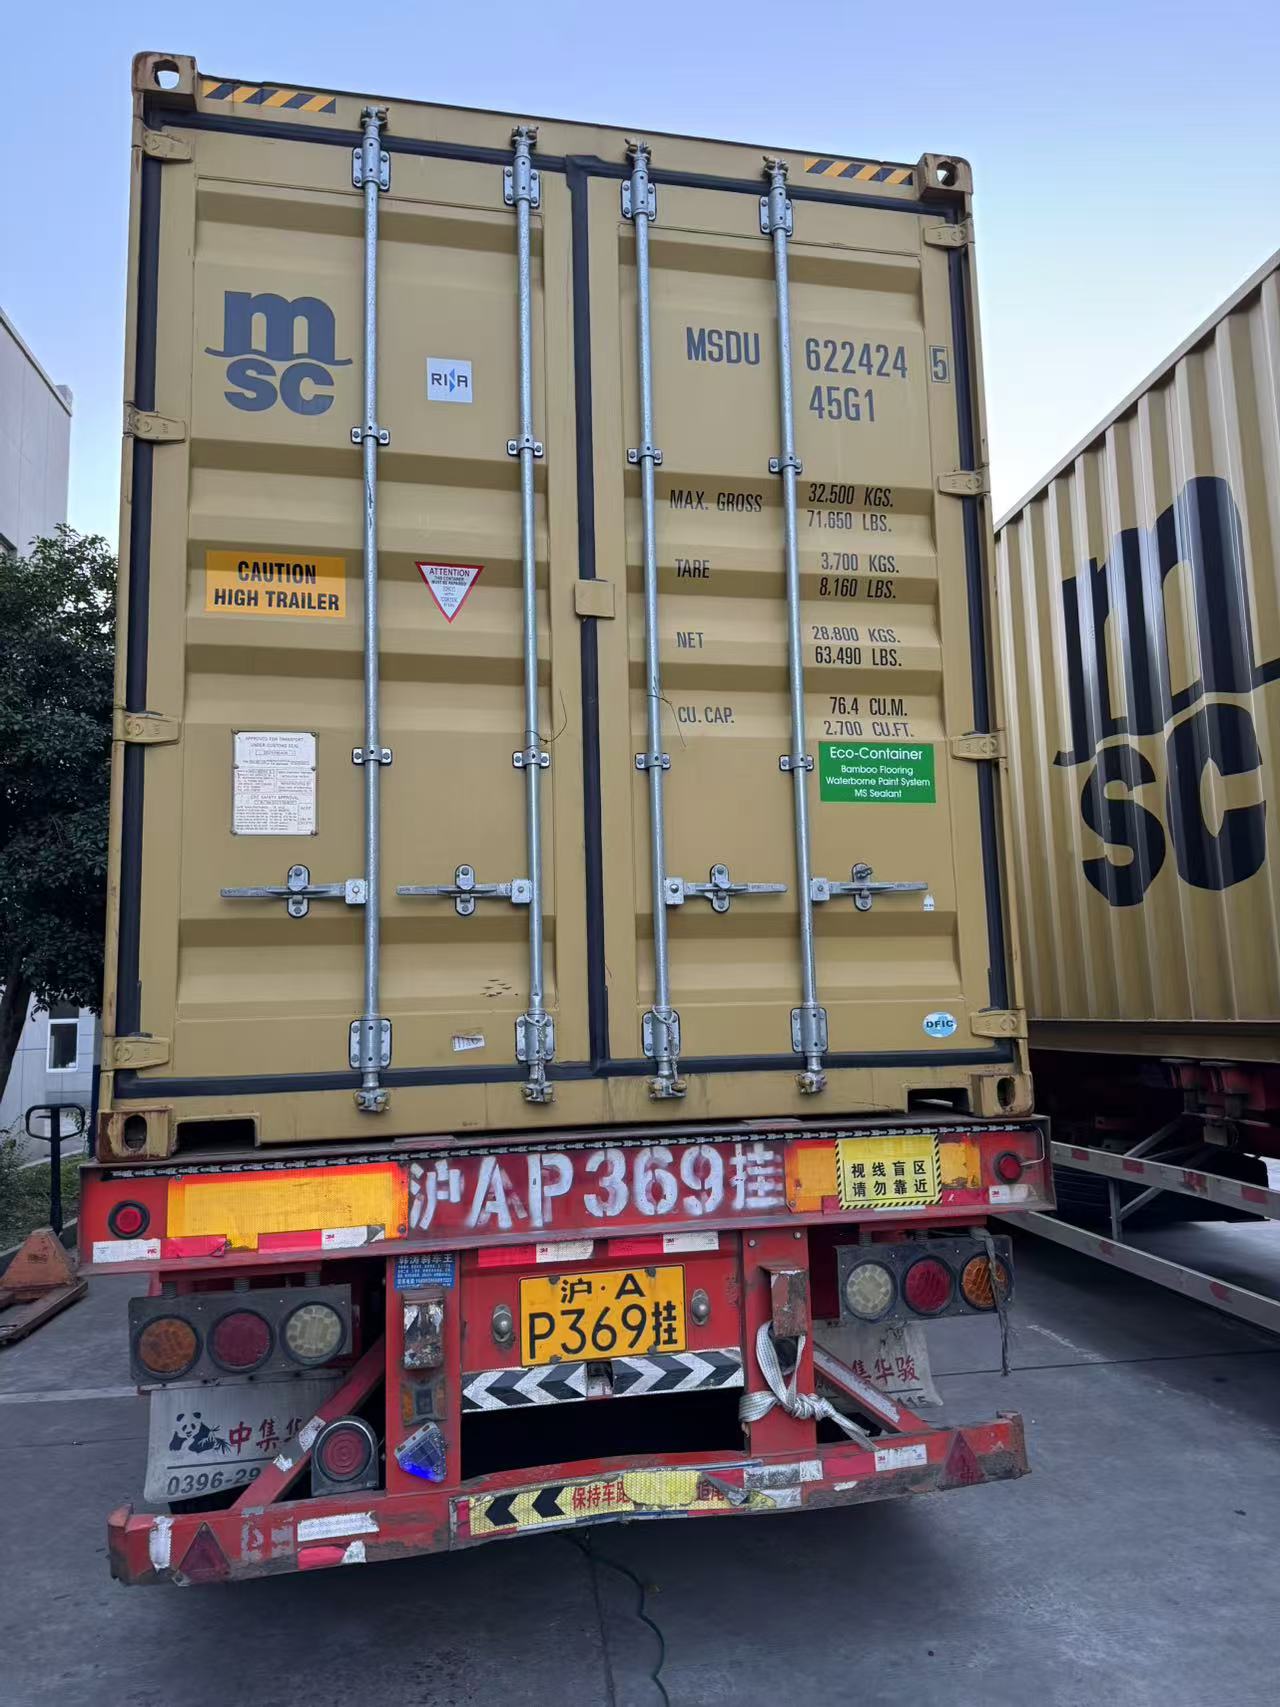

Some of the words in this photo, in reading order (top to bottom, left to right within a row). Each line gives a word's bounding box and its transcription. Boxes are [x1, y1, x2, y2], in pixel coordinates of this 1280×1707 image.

[686, 326, 760, 365] MSDU
[805, 338, 907, 378] 622424
[932, 347, 948, 381] 5
[809, 385, 875, 422] 45G1
[670, 490, 708, 511] MAX.
[717, 492, 762, 512] GROSS
[864, 487, 894, 508] KGS.
[863, 513, 892, 533] LBS.
[238, 560, 316, 584] CAUTION
[429, 567, 470, 577] ATTENTION
[675, 558, 710, 578] TARE
[869, 555, 900, 574] KGS.
[867, 580, 897, 599] LBS.
[214, 588, 259, 607] HIGH
[265, 590, 340, 611] TRAILER
[677, 631, 704, 648] NET
[868, 628, 901, 643] KGS.
[872, 649, 902, 666] LBS.
[705, 707, 735, 723] CAP.
[829, 696, 859, 715] 76.4
[829, 746, 923, 760] Eco-Container
[841, 765, 878, 774] Bamboo
[880, 766, 914, 777] Flooring
[825, 776, 876, 786] Waterborne
[878, 777, 899, 786] Paint
[900, 778, 931, 787] System
[854, 789, 868, 797] MS
[869, 789, 902, 798] Sealant
[851, 1160, 927, 1178] 视线盲区
[852, 1179, 928, 1198] 请勿靠近
[529, 1301, 678, 1360] P369挂
